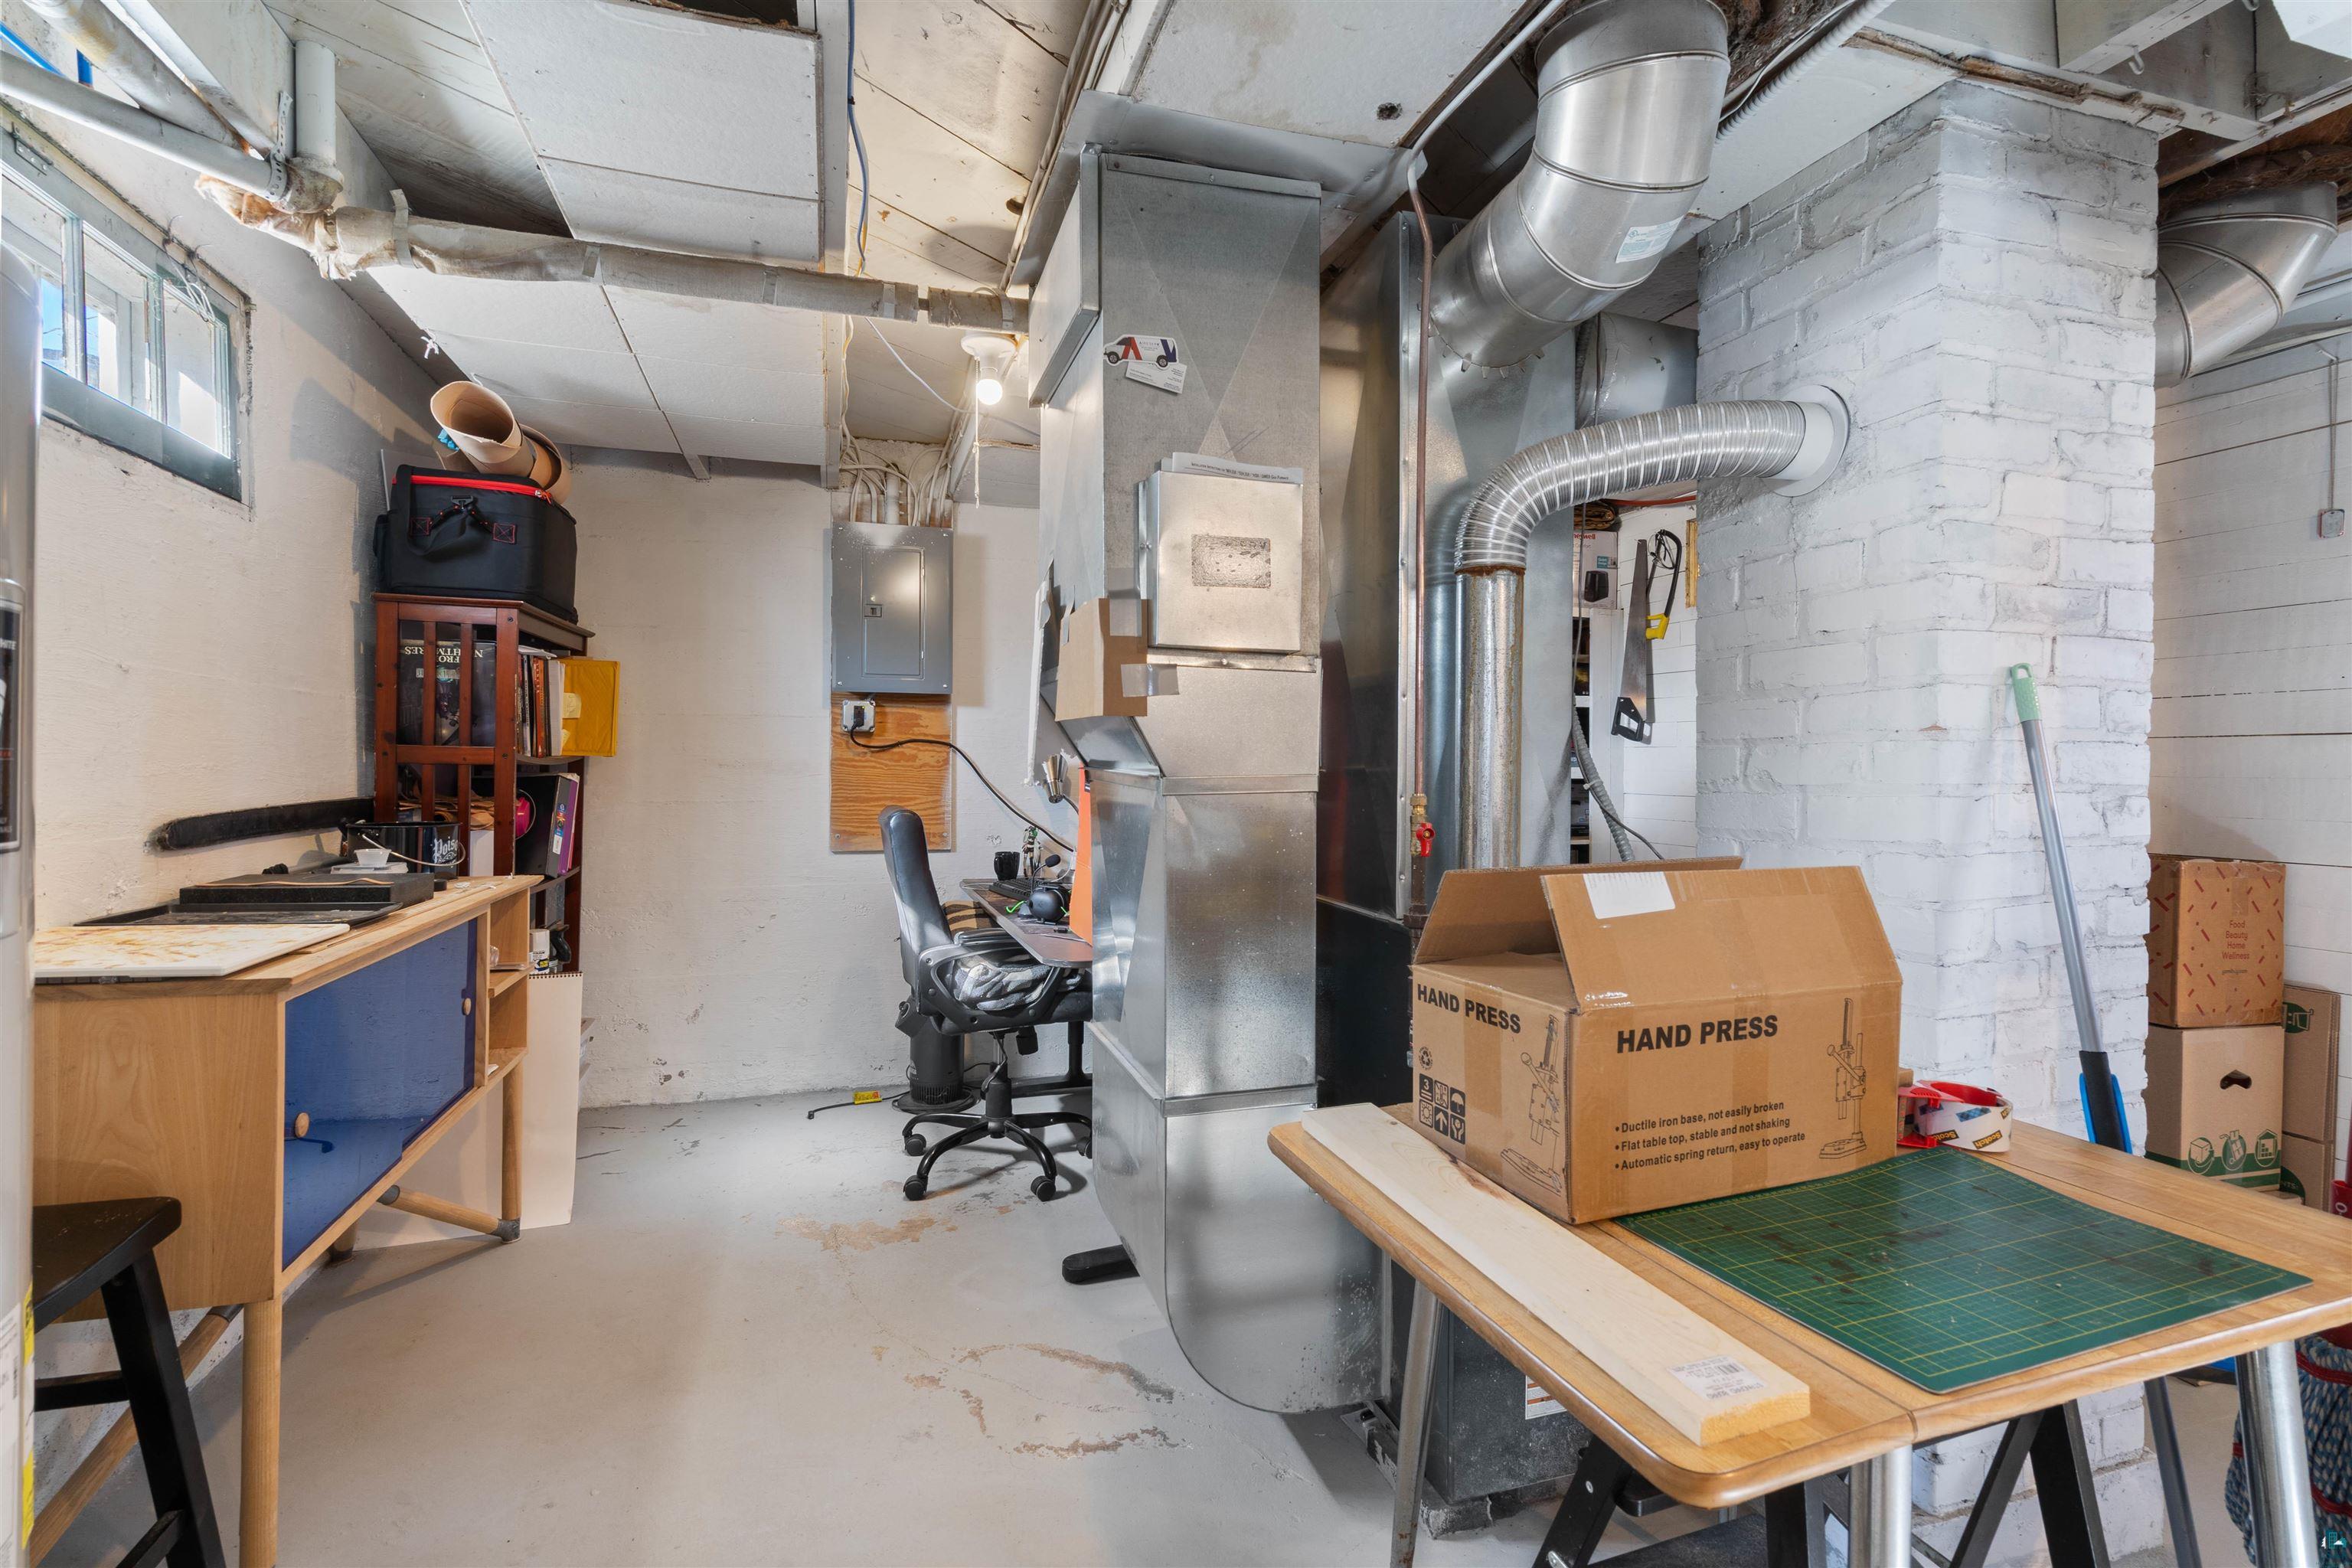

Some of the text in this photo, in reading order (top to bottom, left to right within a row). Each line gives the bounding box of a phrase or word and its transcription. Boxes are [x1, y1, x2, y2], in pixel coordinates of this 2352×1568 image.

[2226, 930, 2248, 941] Beauty
[1417, 984, 1521, 1034] HAND PRESS
[1617, 1014, 1778, 1054] HAND PRESS
[1622, 1102, 1784, 1133] Ductile iron base, not easily broken
[1622, 1118, 1790, 1152] Flat table top, stable and not shaking
[1622, 1132, 1805, 1171] Automatic spring return, easy to operate
[1932, 1131, 2002, 1149] Scotc Scotch
